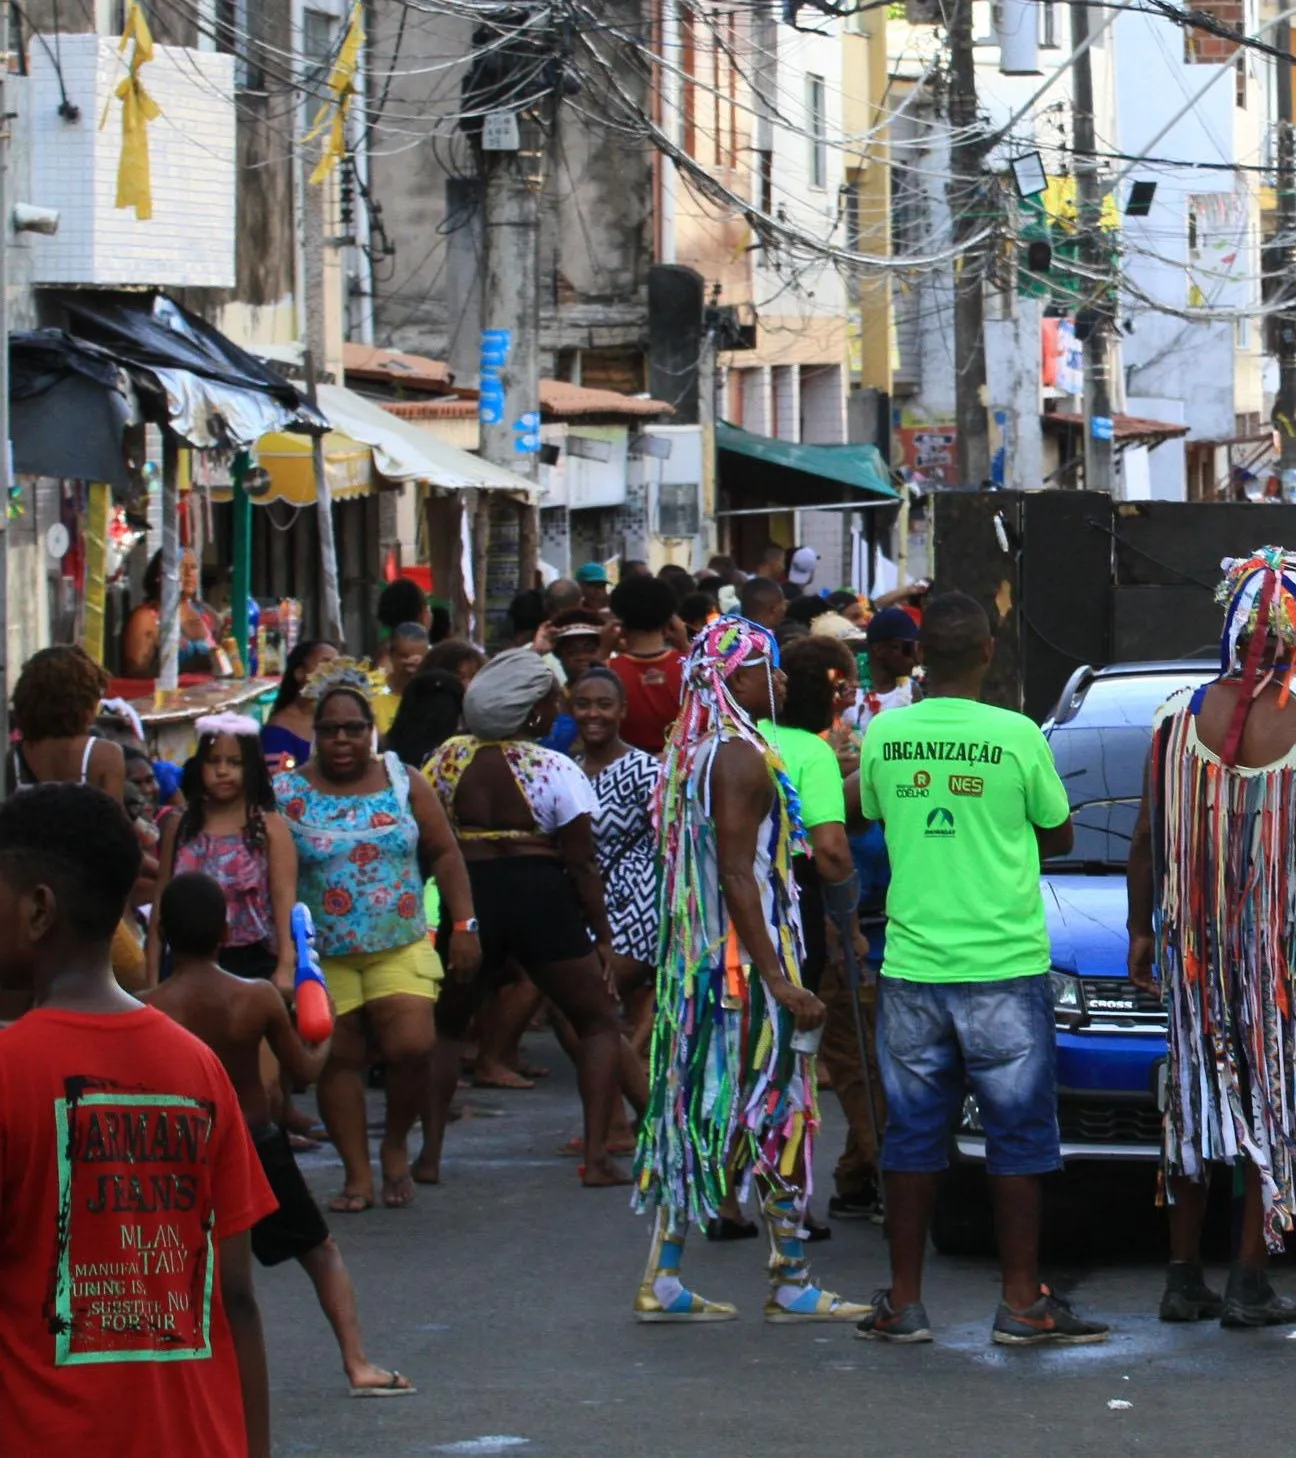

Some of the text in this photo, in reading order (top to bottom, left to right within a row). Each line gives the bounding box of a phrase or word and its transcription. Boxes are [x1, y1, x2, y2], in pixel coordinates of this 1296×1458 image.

[883, 740, 1003, 766] ORGANIZAÇÃO
[896, 788, 929, 798] COELHO
[950, 776, 982, 794] NES
[1089, 999, 1133, 1009] CROSS
[82, 1110, 211, 1165] ARMAN
